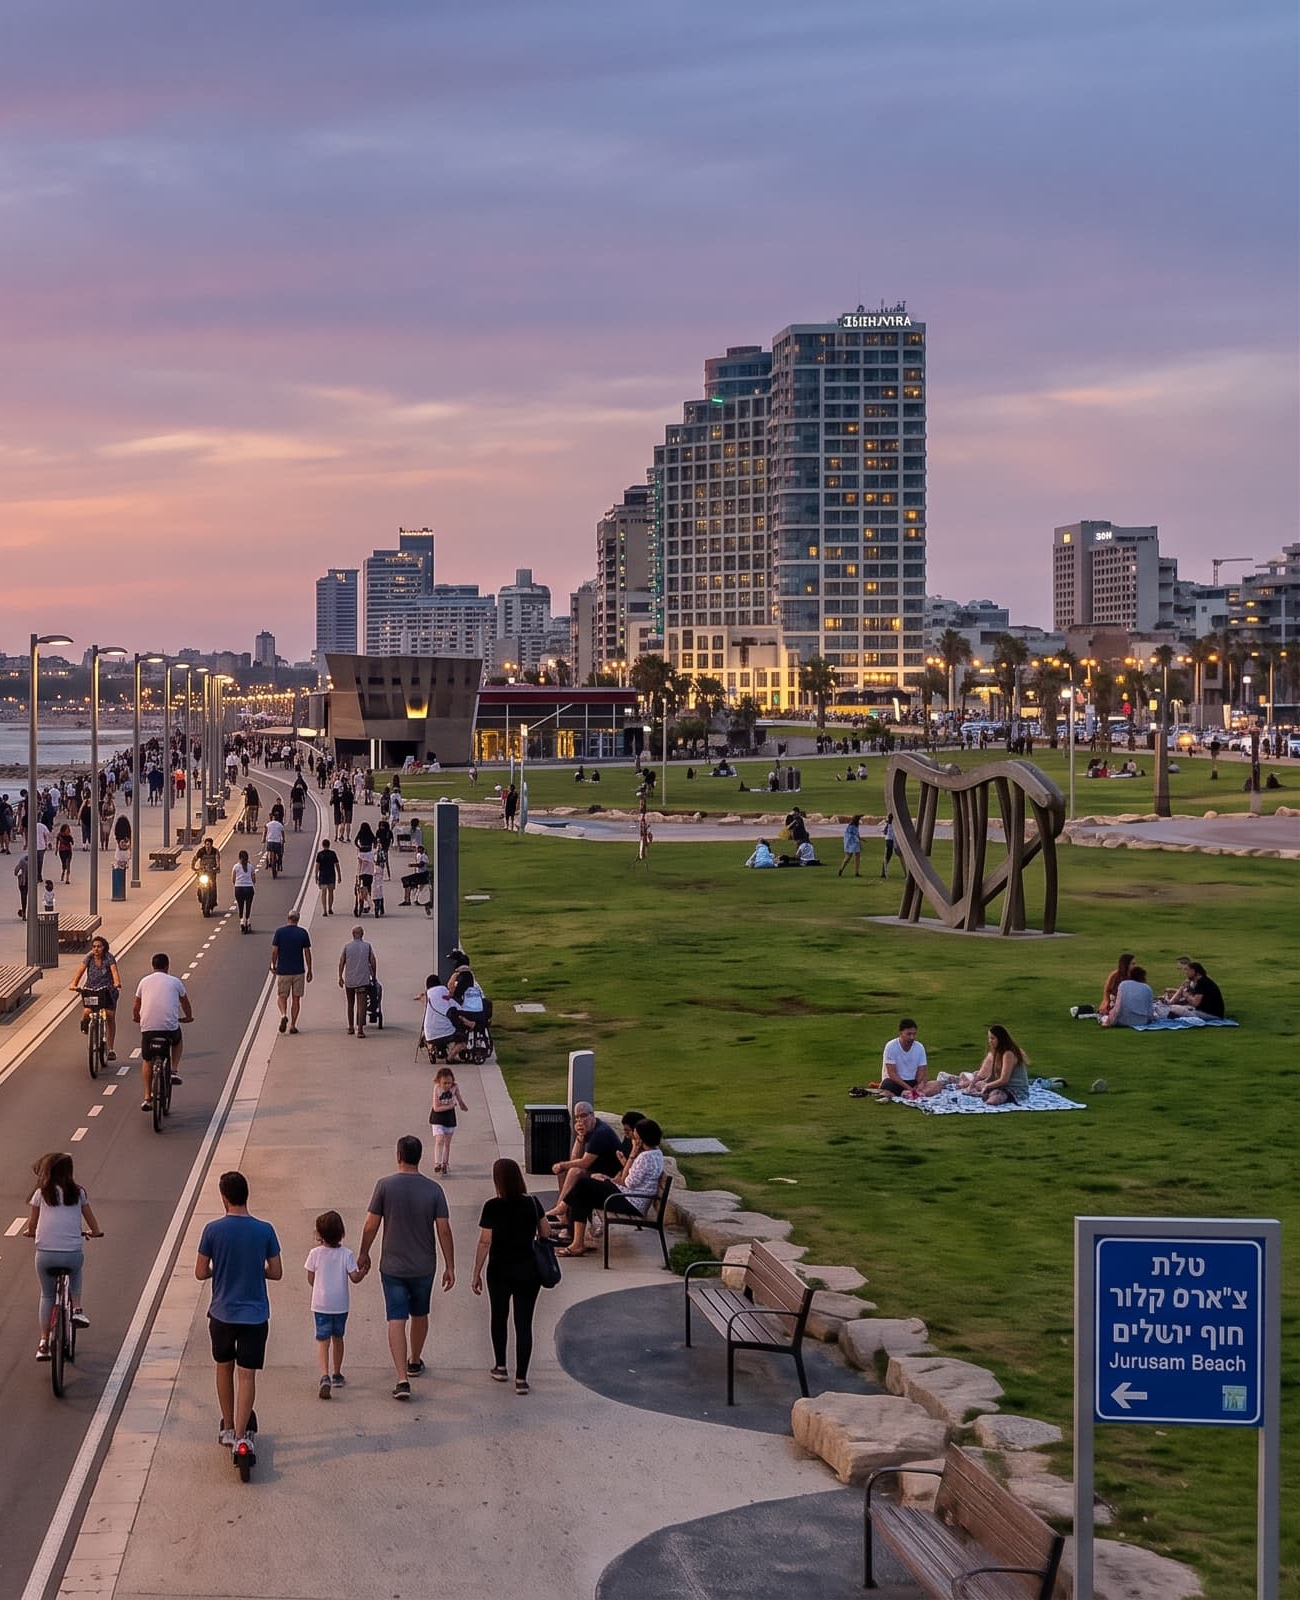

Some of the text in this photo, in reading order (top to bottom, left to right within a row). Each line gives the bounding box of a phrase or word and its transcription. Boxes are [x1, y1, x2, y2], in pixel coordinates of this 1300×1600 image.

[1151, 1252, 1206, 1277] טלת
[1109, 1283, 1165, 1314] קלור
[1200, 1325, 1244, 1351] חוף
[1109, 1353, 1246, 1372] Jurusam Beach
